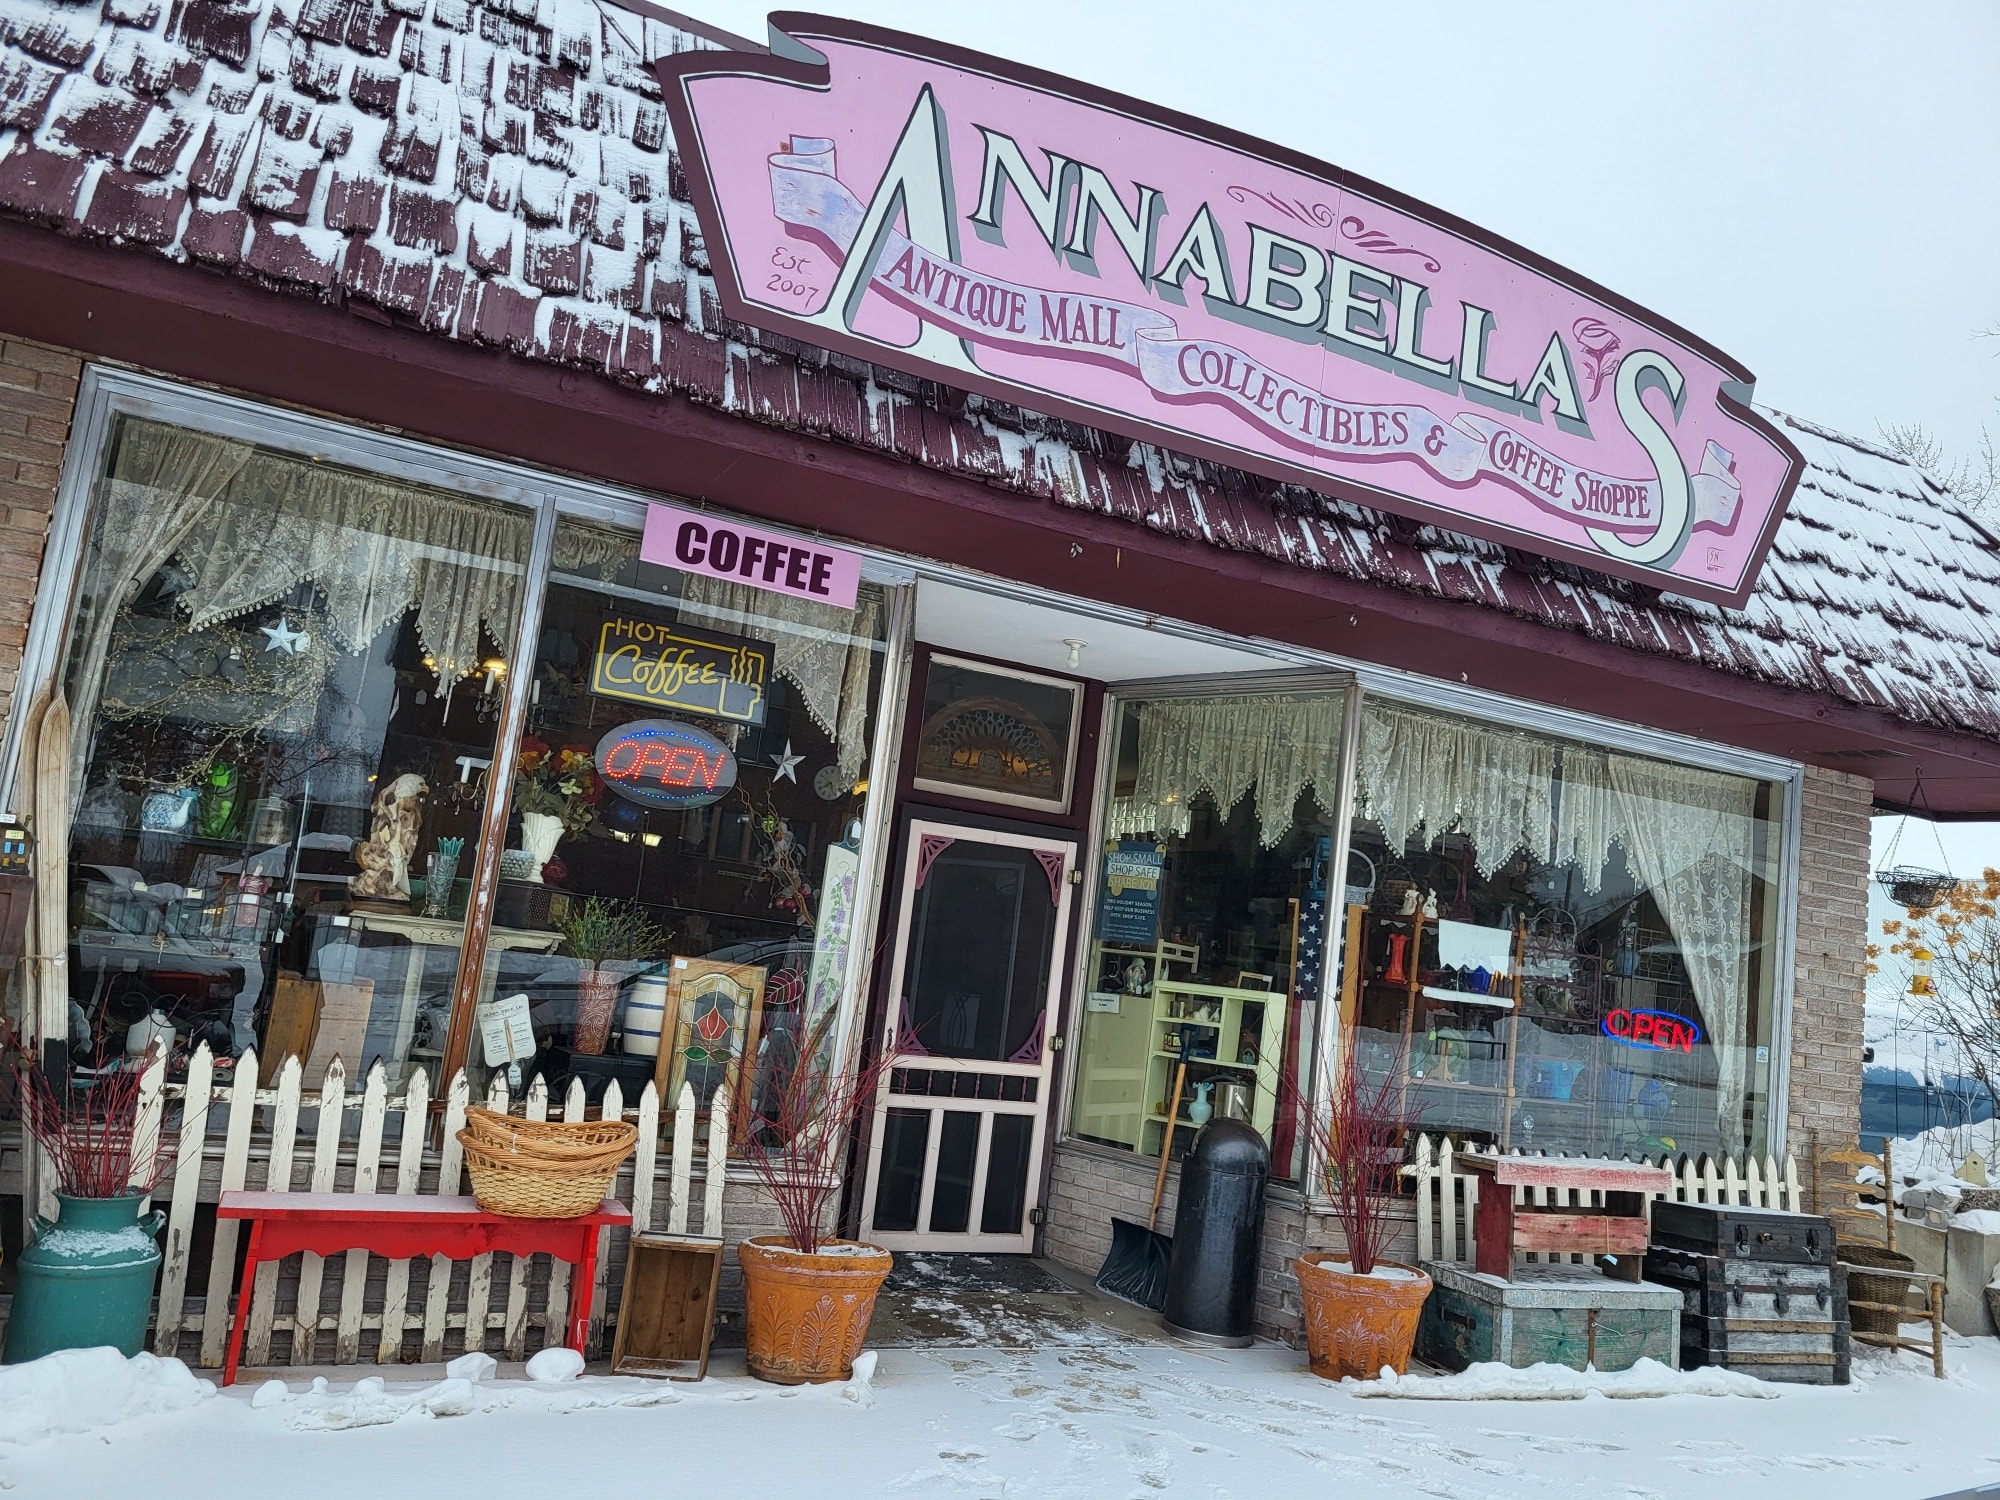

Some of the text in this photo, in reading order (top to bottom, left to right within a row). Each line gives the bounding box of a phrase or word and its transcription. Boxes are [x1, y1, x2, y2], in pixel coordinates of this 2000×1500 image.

[766, 273, 820, 310] 2007
[881, 245, 1126, 350] ANTIQUE MALL
[1177, 344, 1448, 457] COLLECTIBLES &
[1489, 430, 1651, 519] COFFEE SHOPPE
[674, 520, 834, 596] COFFEE
[615, 617, 670, 645] HOT
[605, 644, 719, 695] Coffee
[606, 740, 725, 789] OPEN
[1108, 852, 1162, 865] SHOP SMALL
[1110, 863, 1157, 878] SHOP SAFE
[1108, 876, 1156, 890] SHARE JOY
[1606, 1008, 1694, 1054] OPEN
